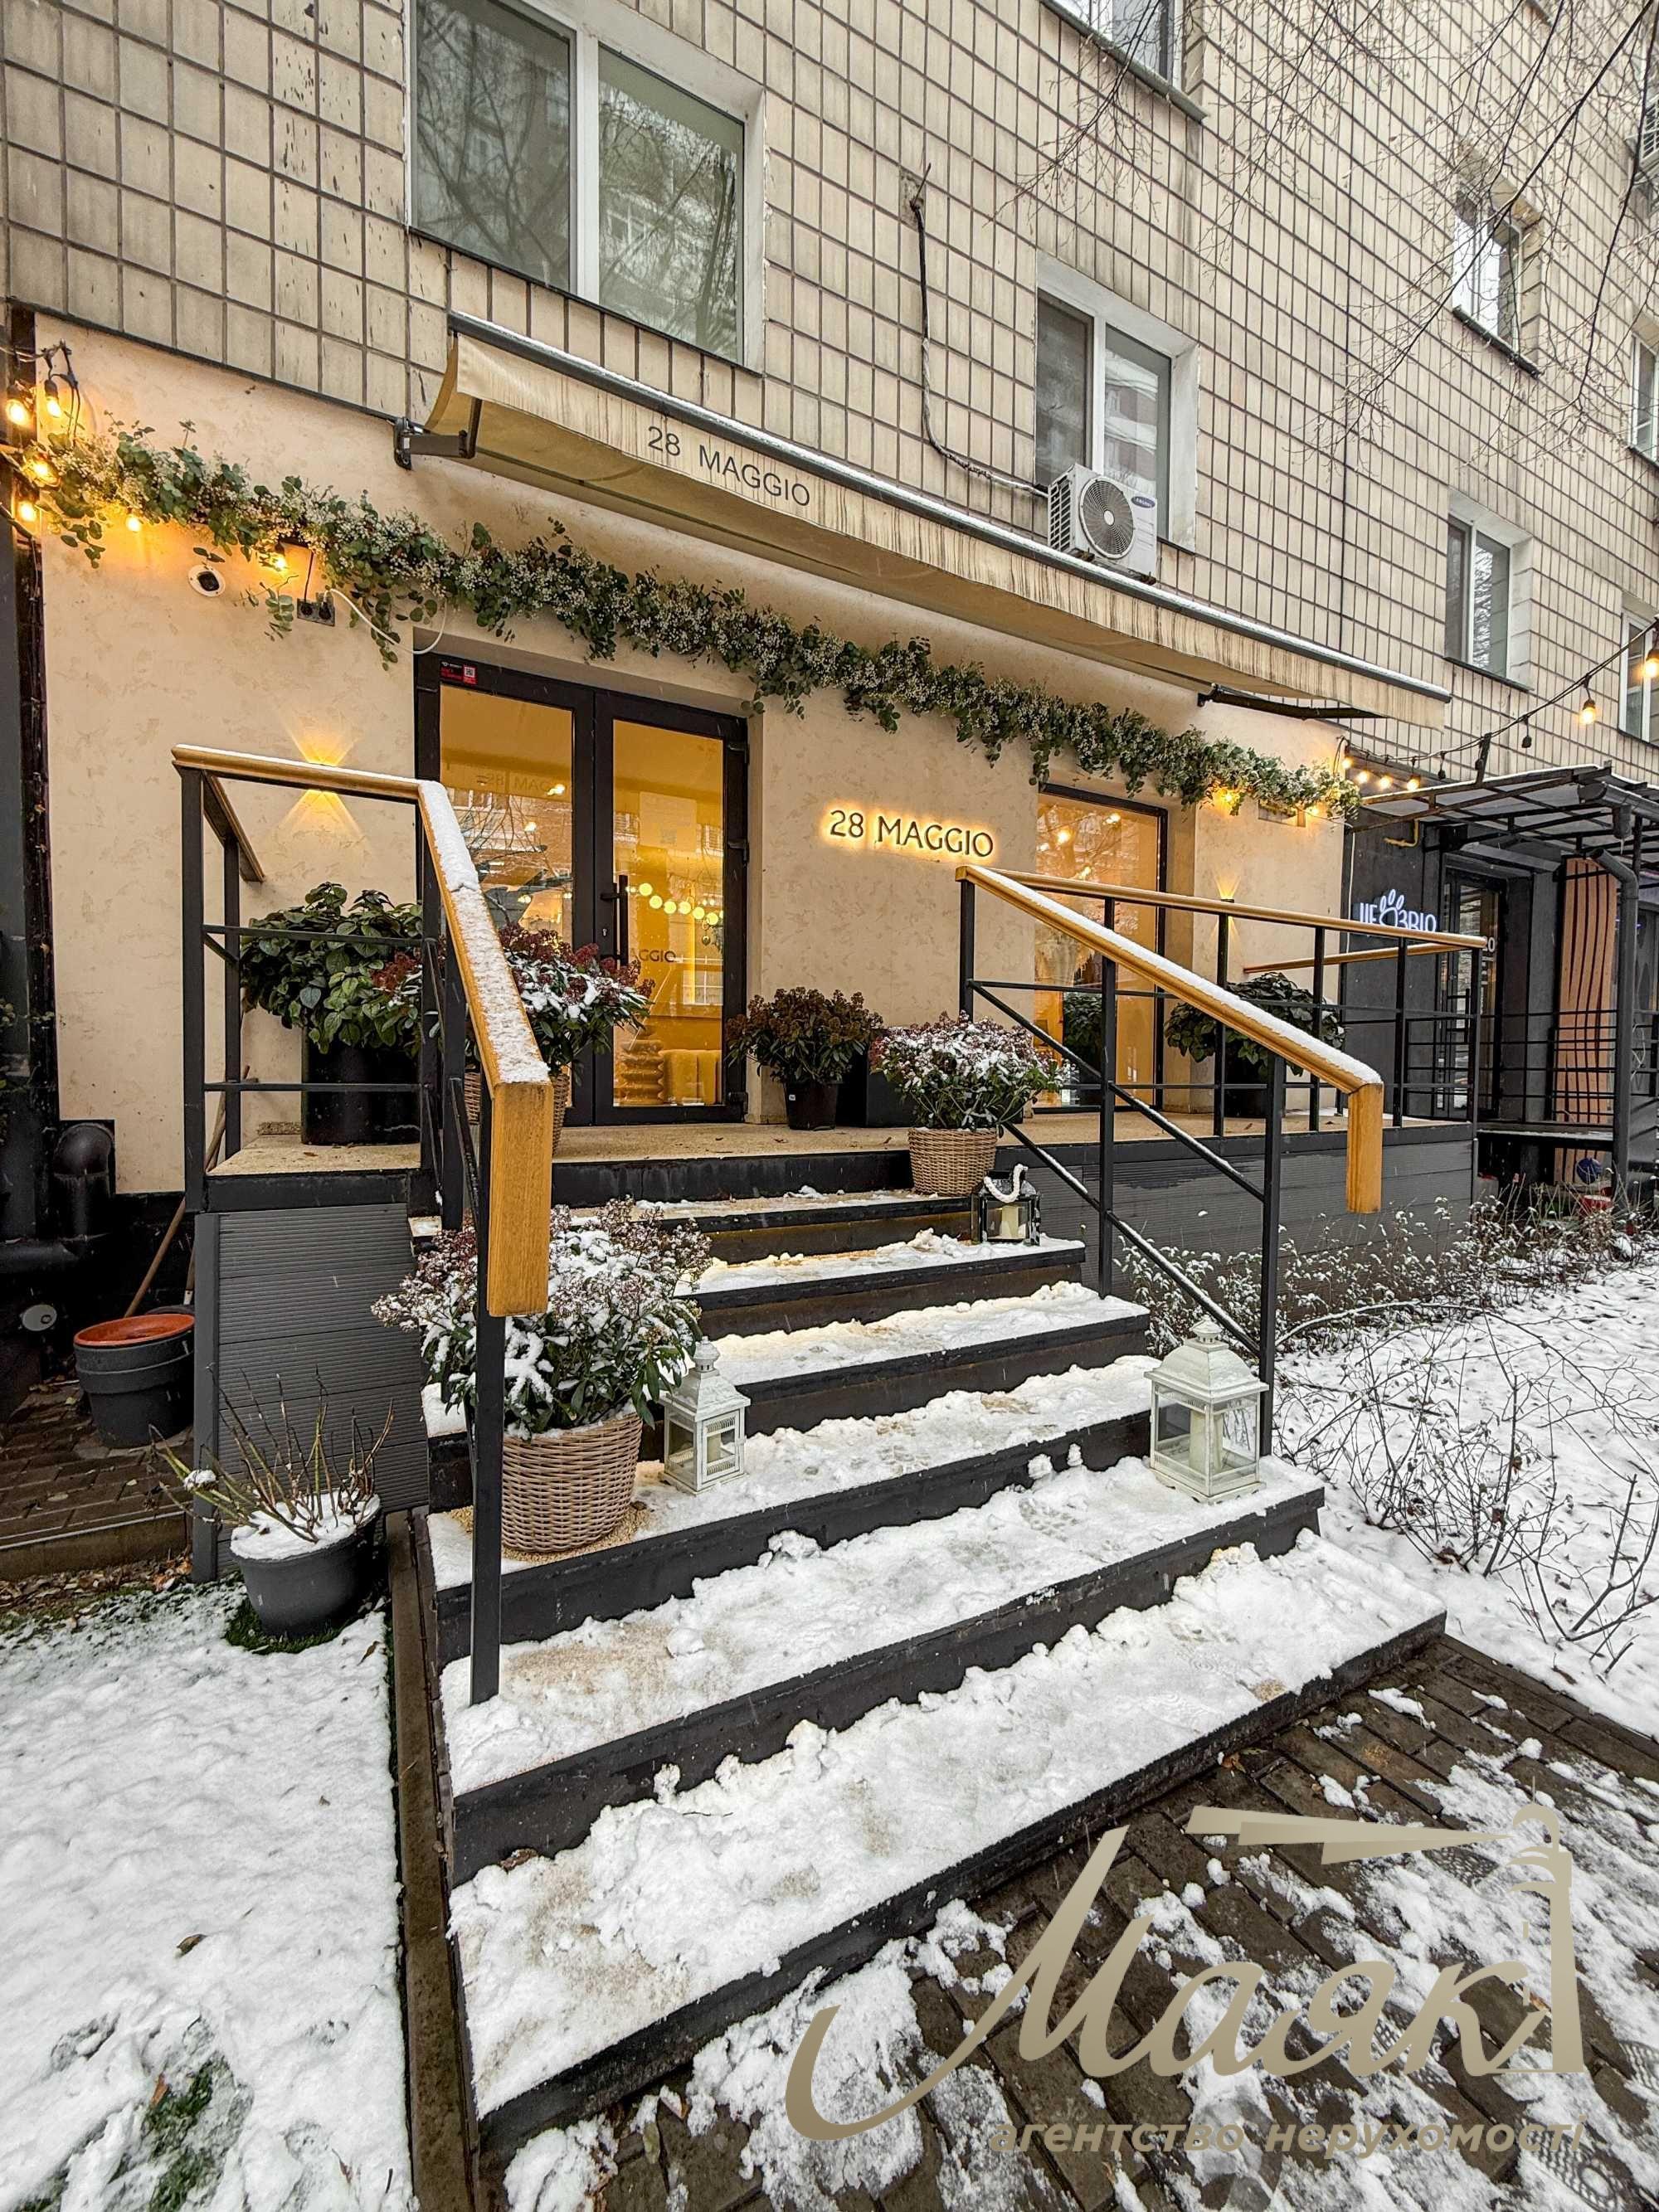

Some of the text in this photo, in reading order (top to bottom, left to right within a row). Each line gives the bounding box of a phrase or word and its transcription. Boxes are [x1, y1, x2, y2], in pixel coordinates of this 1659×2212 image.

[647, 425, 810, 507] 28 MAGGIO
[830, 809, 994, 858] 28 MAGGIO
